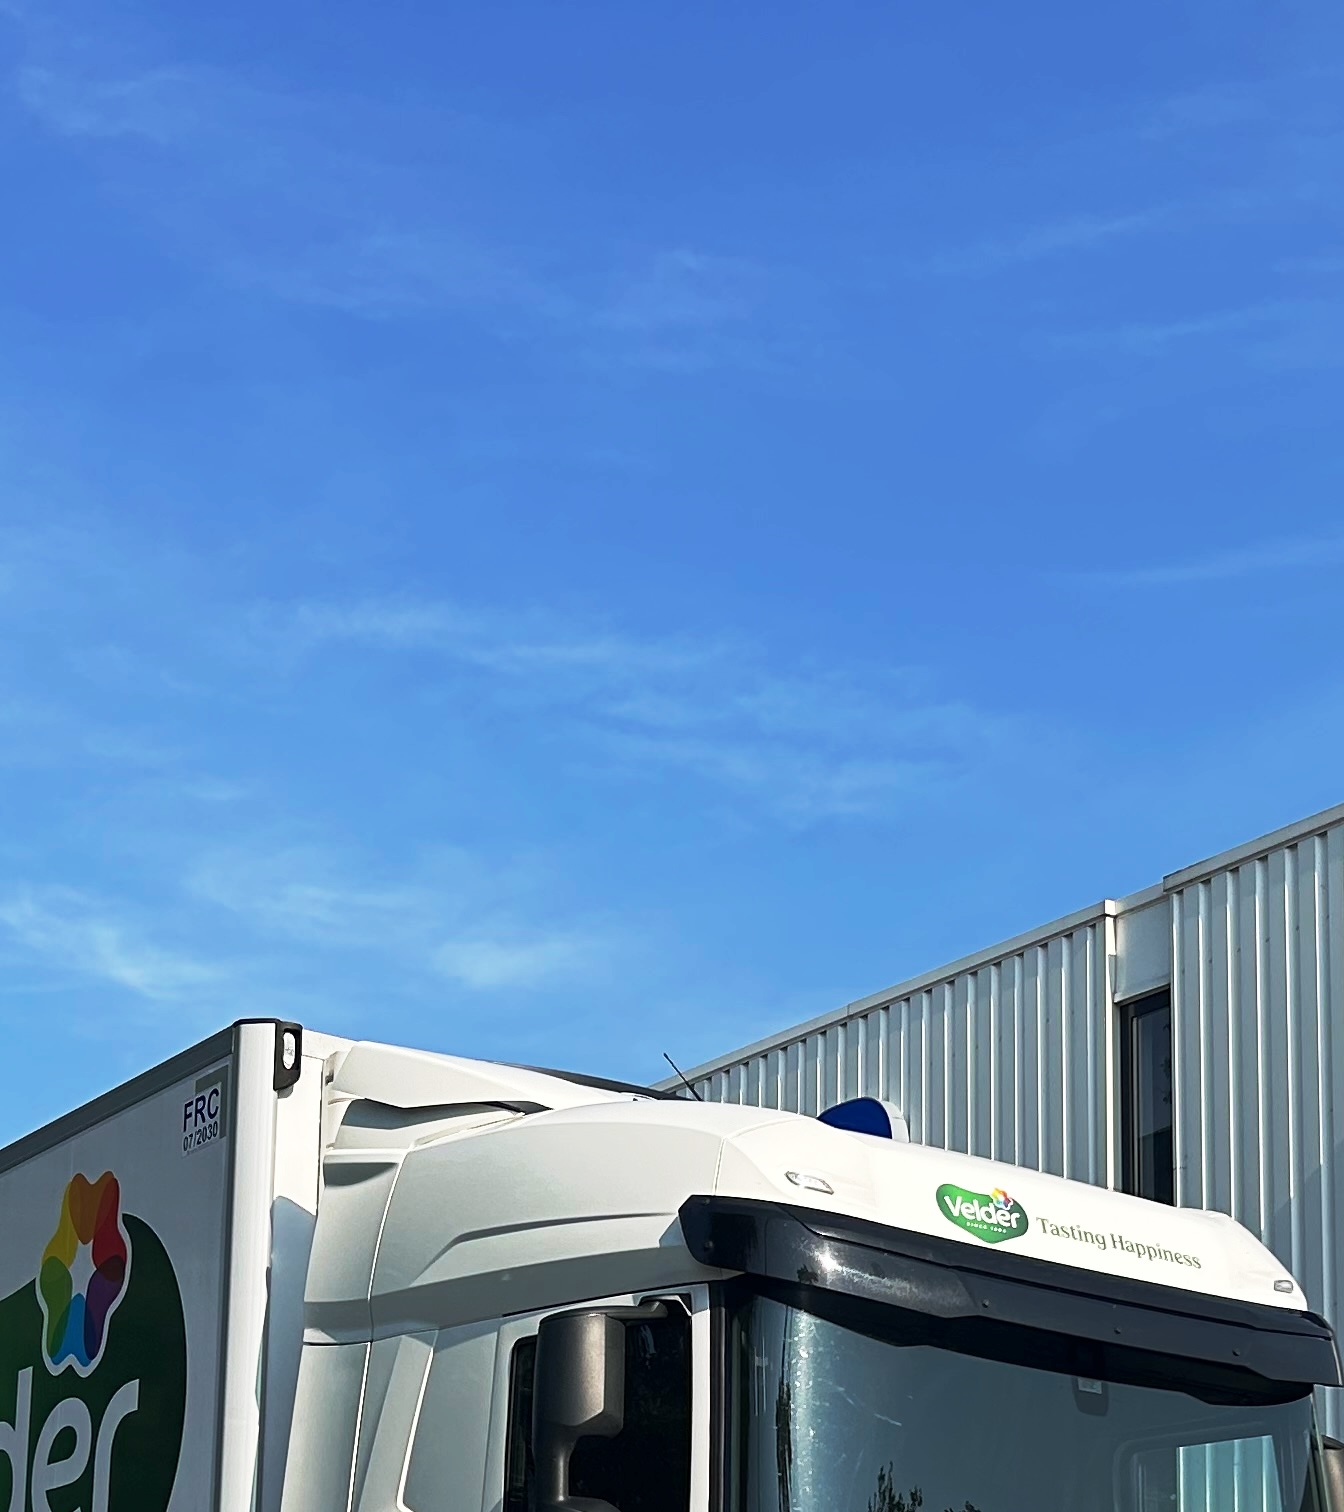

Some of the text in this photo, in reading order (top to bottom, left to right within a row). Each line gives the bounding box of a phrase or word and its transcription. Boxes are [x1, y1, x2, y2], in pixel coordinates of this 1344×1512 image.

[183, 1088, 219, 1132] FRC
[183, 1120, 218, 1152] 07/2030
[943, 1195, 1020, 1228] Velder
[1036, 1216, 1202, 1269] Tasting Happiness
